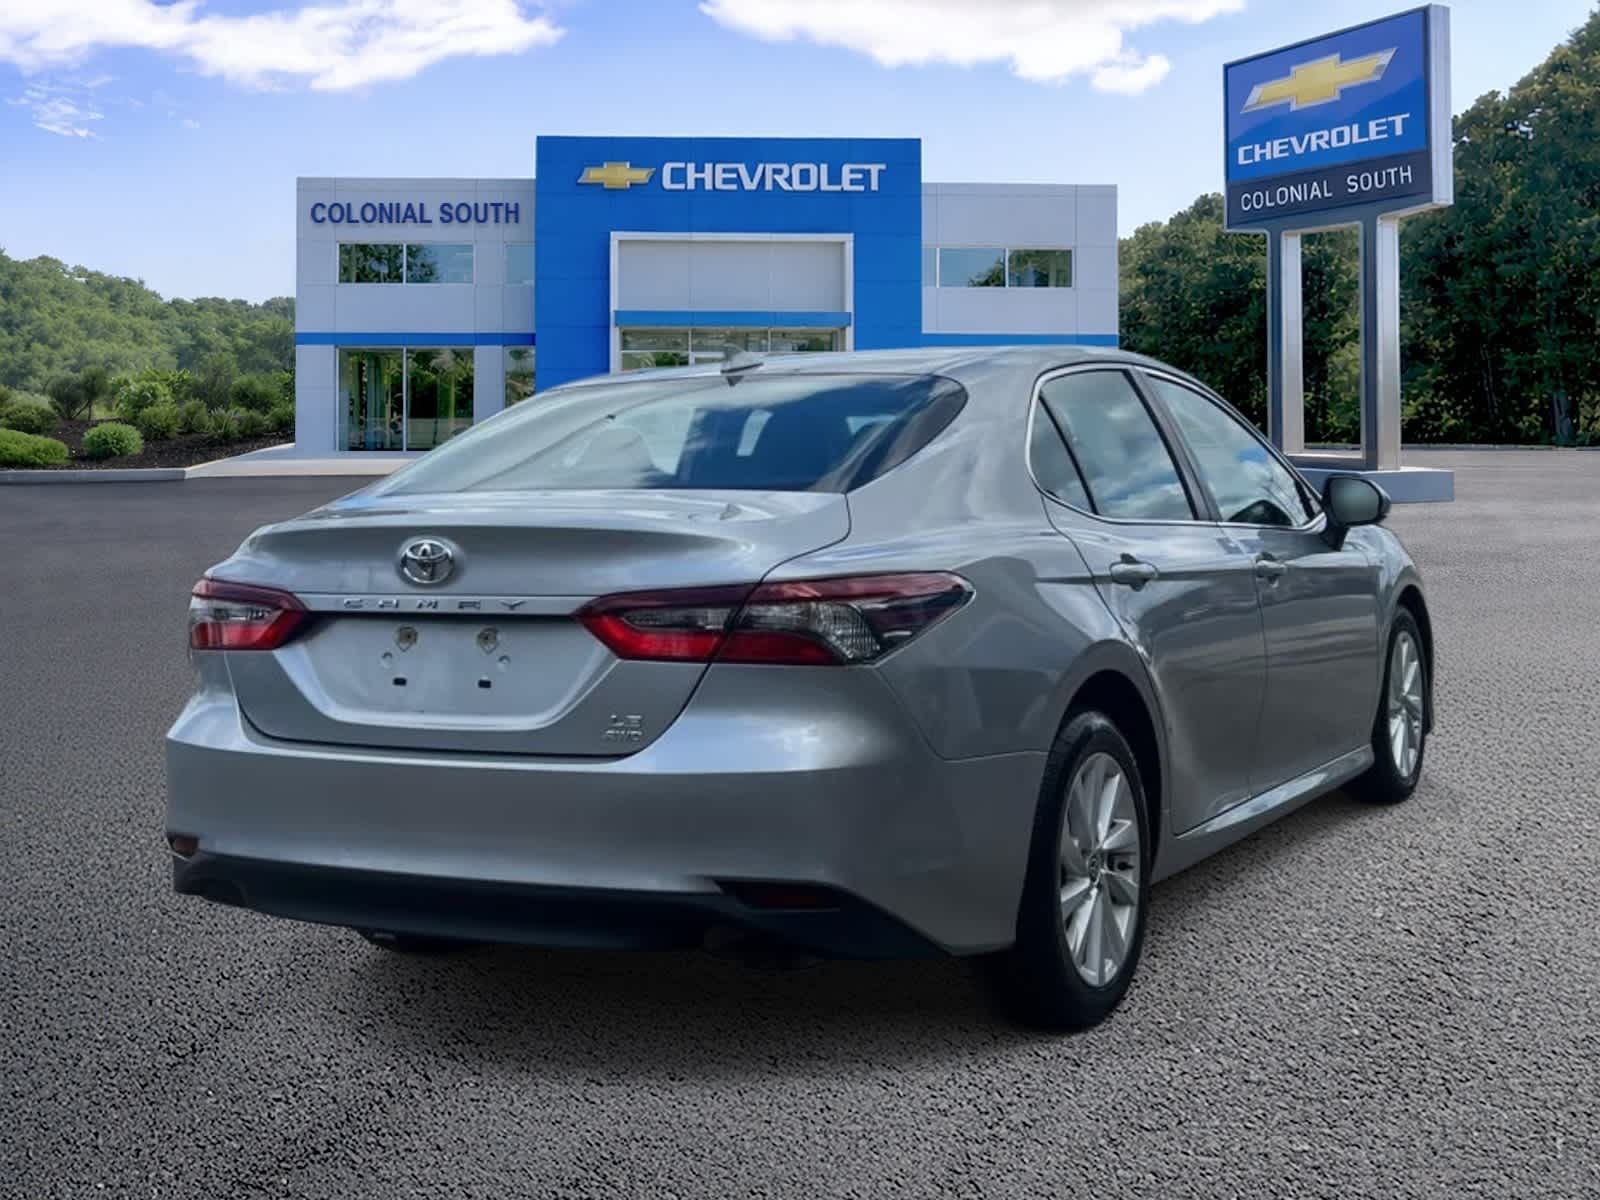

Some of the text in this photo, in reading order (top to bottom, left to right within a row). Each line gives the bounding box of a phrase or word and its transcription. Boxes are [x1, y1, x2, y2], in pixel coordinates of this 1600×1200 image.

[1237, 113, 1410, 165] CHEVROLET
[662, 162, 887, 192] CHEVROLET
[1240, 165, 1413, 211] COLONIAL SOUTH
[310, 202, 521, 225] COLONIAL SOUTH
[343, 598, 527, 610] CAMRY
